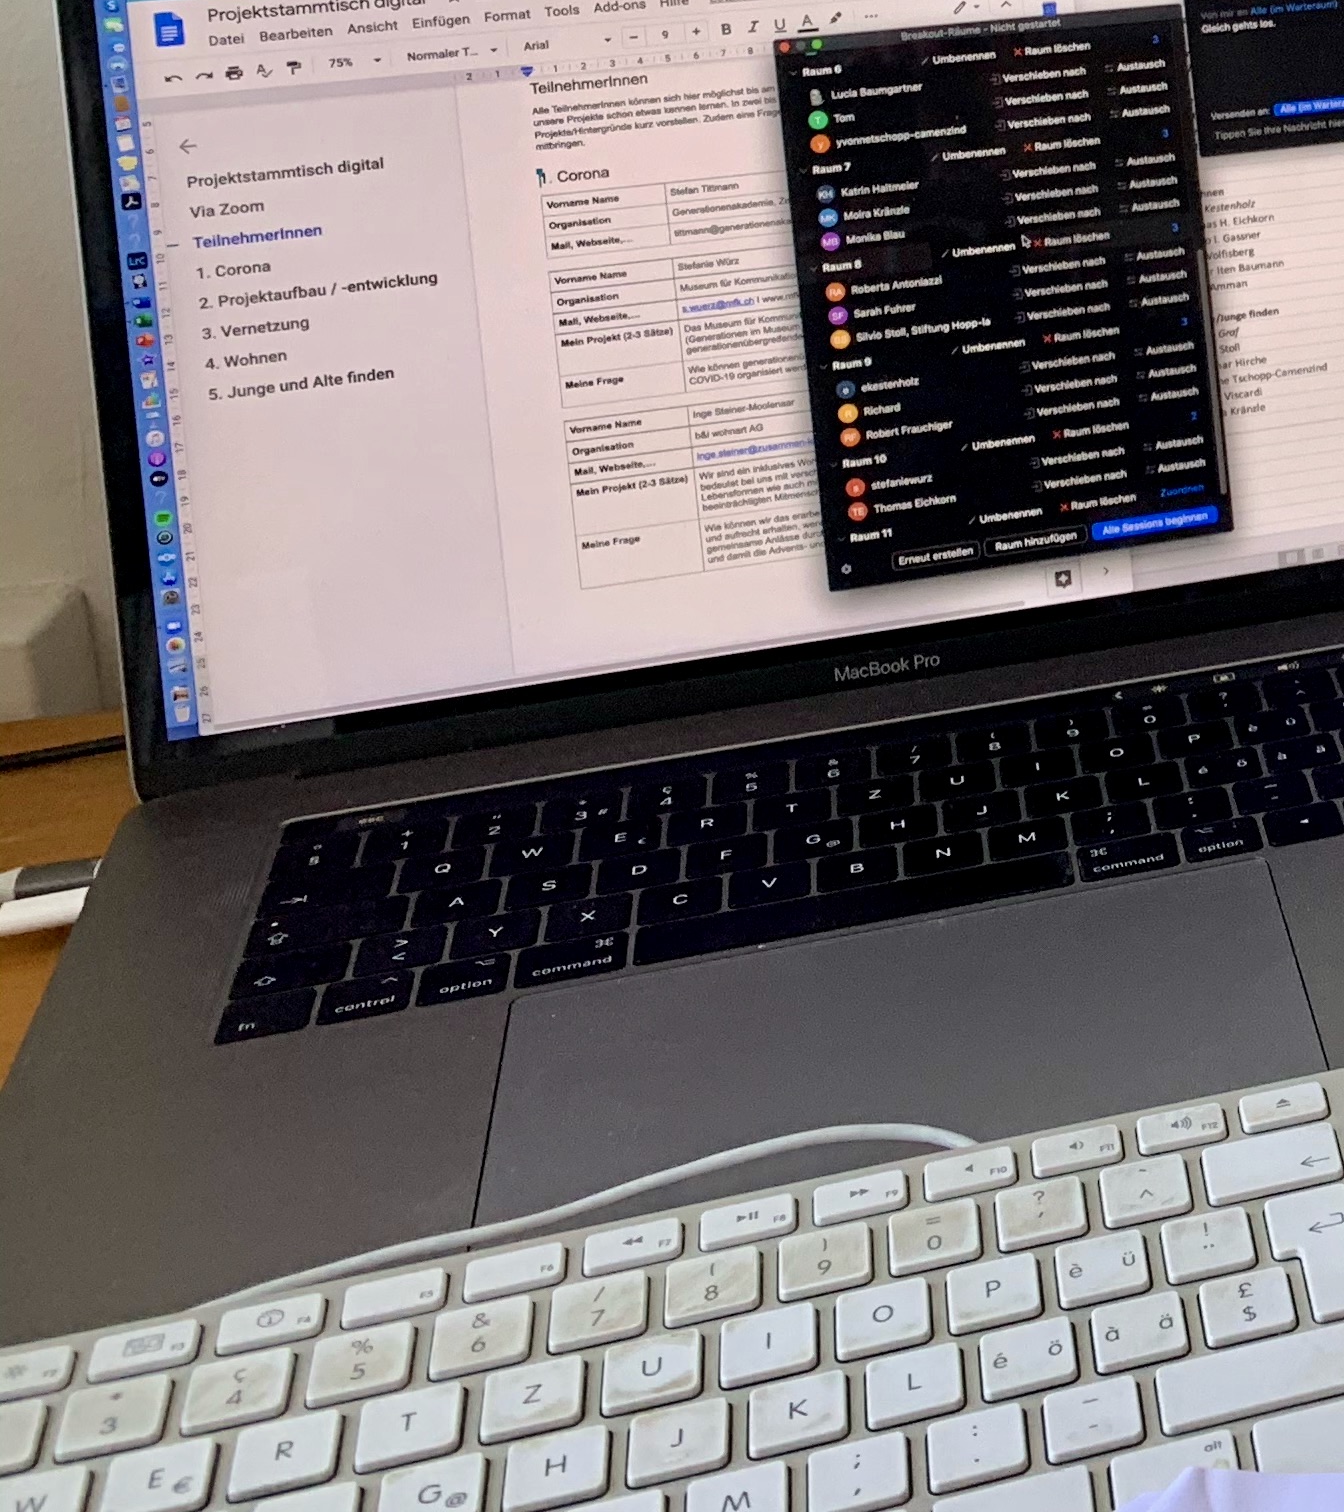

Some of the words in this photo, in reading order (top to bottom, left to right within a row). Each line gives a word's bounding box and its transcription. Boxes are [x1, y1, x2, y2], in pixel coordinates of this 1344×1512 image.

[208, 32, 245, 47] Datei
[258, 27, 334, 43] Bearbeiten
[347, 20, 398, 35] Ansicht
[412, 11, 471, 29] Einfügen
[484, 9, 532, 23] Format
[544, 4, 581, 18] Tools
[593, 0, 647, 14] Add-ons
[523, 39, 550, 52] Arial
[801, 66, 833, 78] Raum
[932, 51, 997, 65] Umbenennen
[1024, 46, 1053, 56] Raum
[1053, 41, 1092, 54] löschen
[529, 74, 649, 95] TeilnehmerInnen
[186, 161, 334, 190] Projektstammtisch
[337, 156, 384, 175] digital
[556, 168, 610, 183] Corona
[189, 205, 216, 219] Via
[218, 202, 265, 216] Zoom
[192, 226, 323, 249] TeilnehmerInnen
[196, 267, 211, 280] 1.
[215, 262, 272, 278] Corona
[198, 296, 214, 310] 2.
[217, 285, 327, 308] Projektaufbau
[341, 273, 438, 293] -entwicklung
[201, 327, 217, 341] 3.
[220, 318, 310, 338] Vernetzung
[205, 357, 220, 370] 4.
[223, 351, 288, 368] Wohnen
[208, 387, 223, 401] 5.
[227, 383, 276, 399] Junge
[279, 376, 309, 393] und
[312, 374, 344, 389] Alte
[346, 368, 395, 384] finden
[833, 657, 910, 682] MacBook
[913, 654, 941, 670] Pro
[531, 955, 613, 977] command
[439, 978, 493, 994] option
[334, 994, 396, 1014] control
